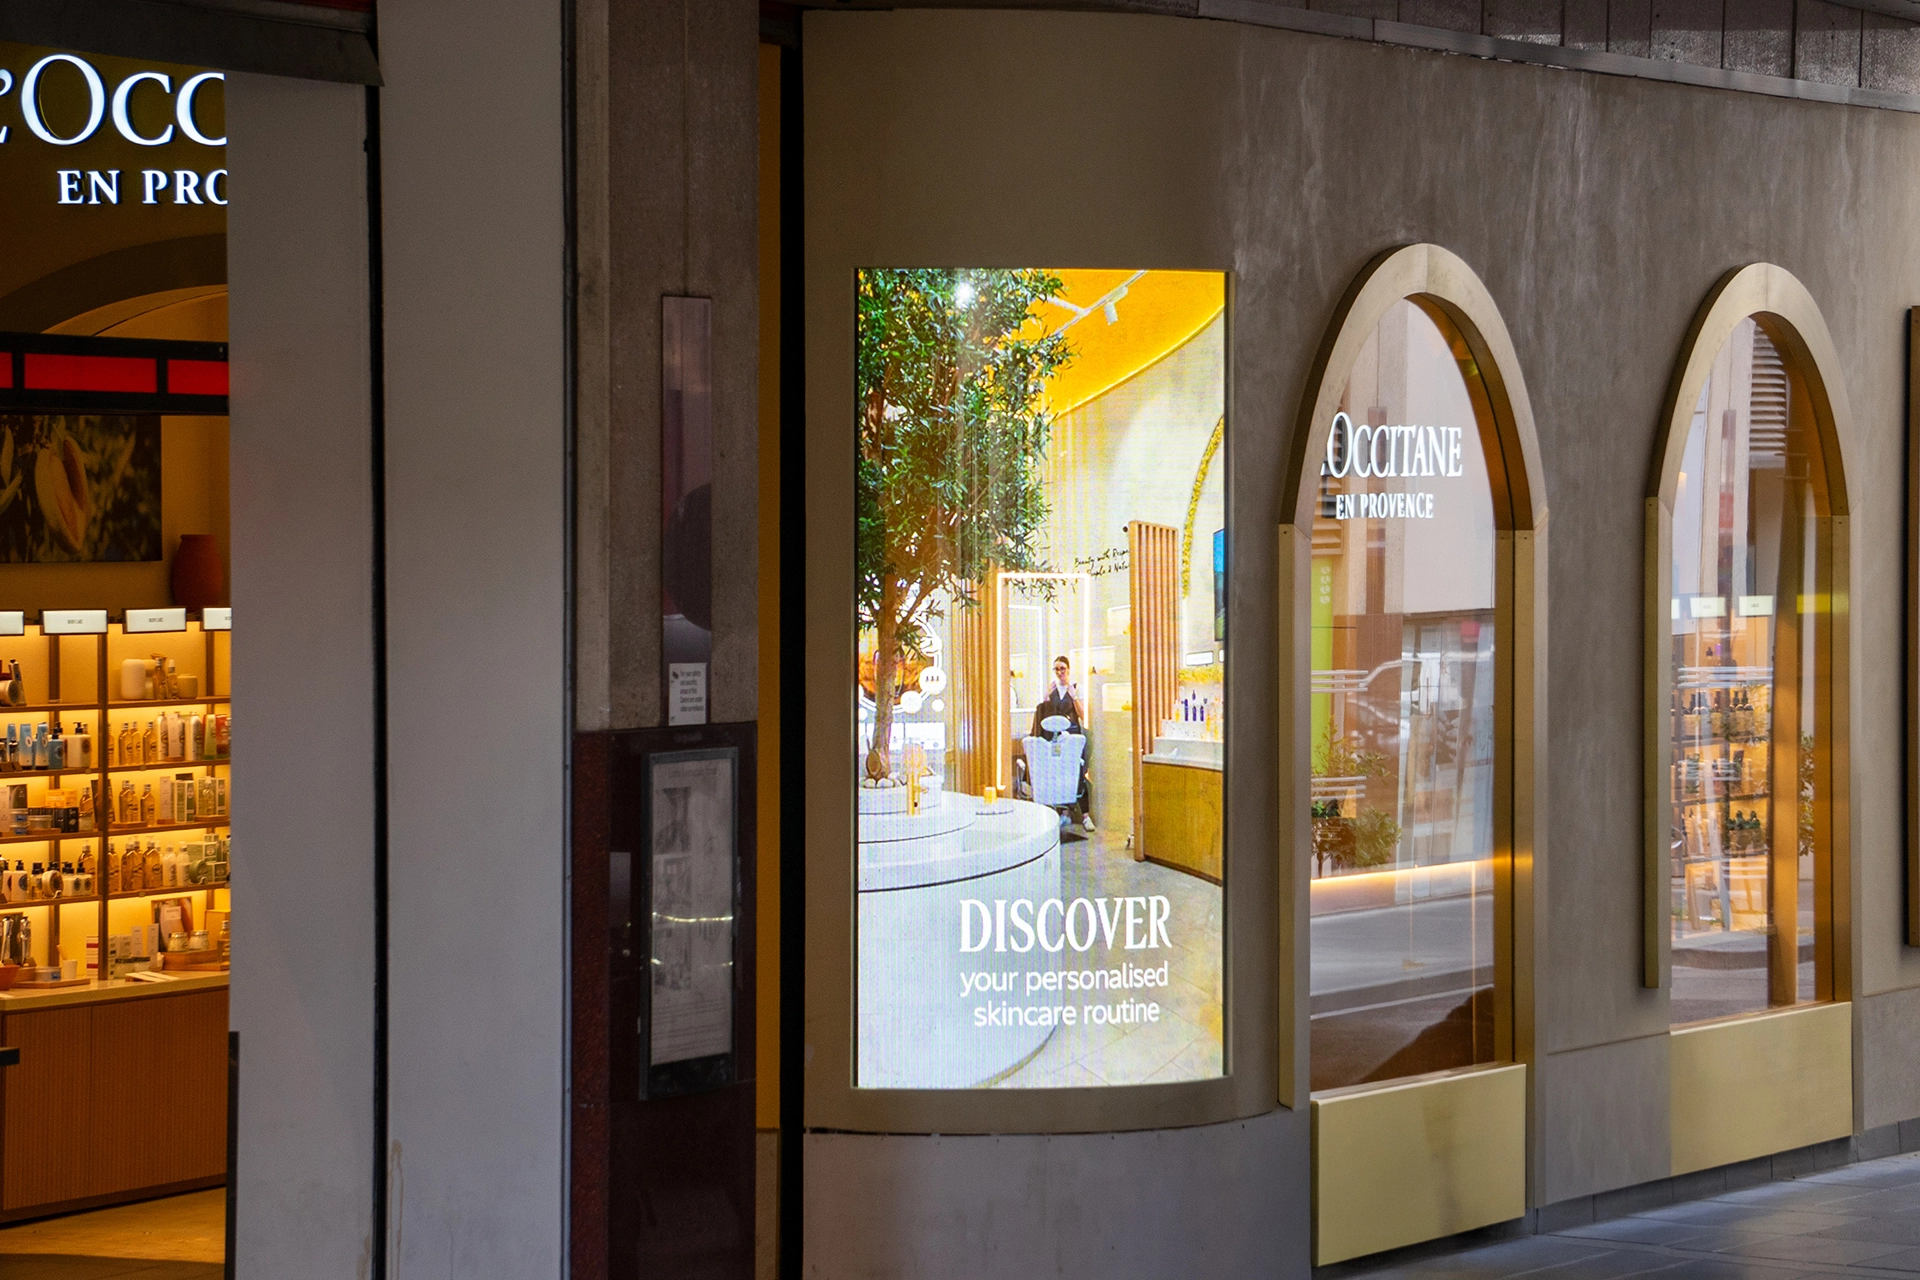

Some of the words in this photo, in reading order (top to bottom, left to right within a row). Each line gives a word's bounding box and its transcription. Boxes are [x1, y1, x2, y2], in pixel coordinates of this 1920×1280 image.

[57, 170, 120, 205] EN
[1320, 411, 1463, 478] OCCITANE
[1336, 493, 1355, 520] EN
[1360, 492, 1434, 519] PROVENCE
[959, 895, 1173, 953] DISCOVER
[959, 970, 1019, 998] your
[1026, 961, 1169, 997] personalised
[974, 999, 1077, 1027] skincare
[1083, 998, 1160, 1025] routine
